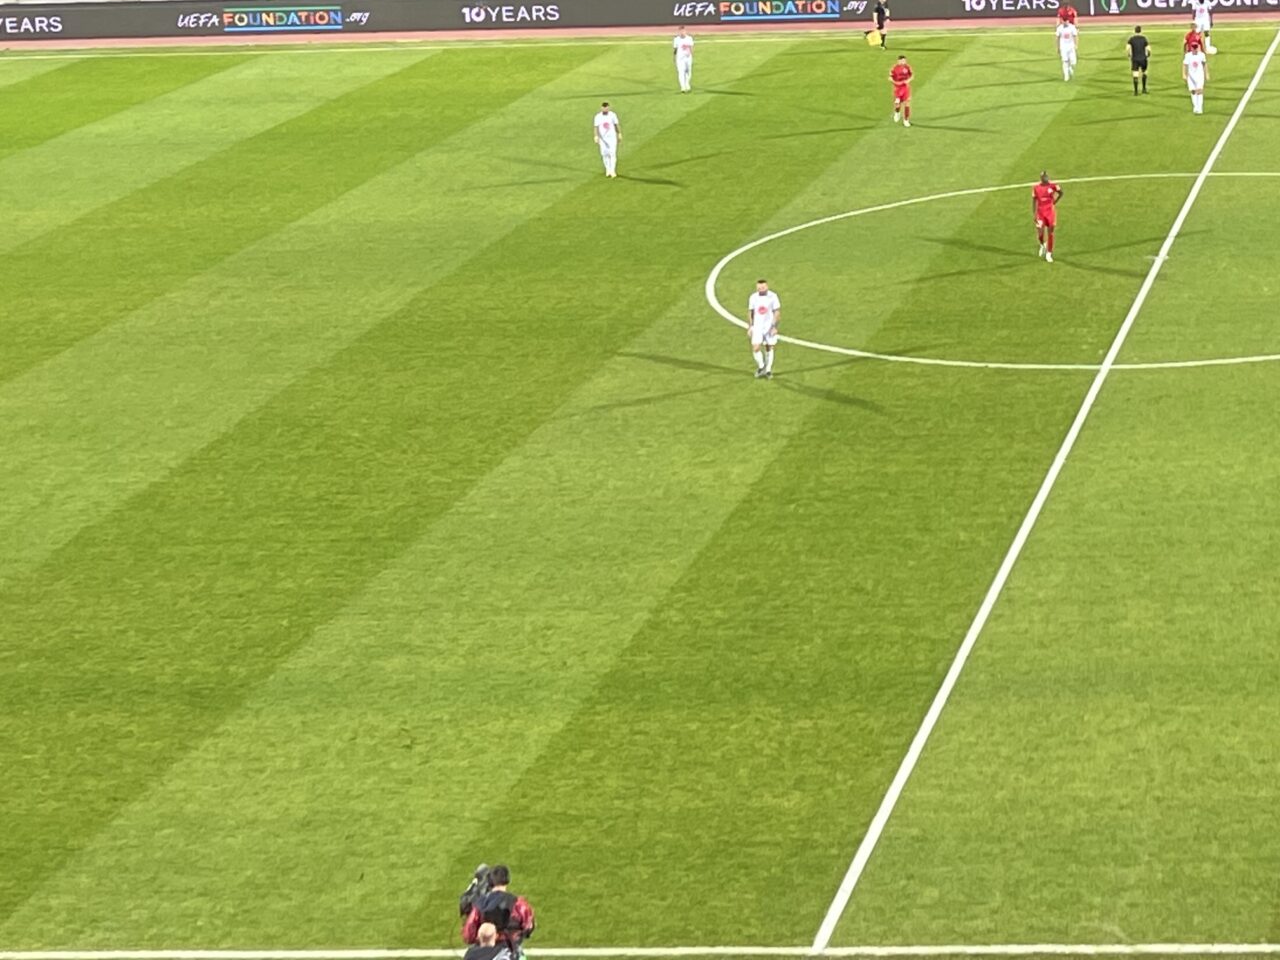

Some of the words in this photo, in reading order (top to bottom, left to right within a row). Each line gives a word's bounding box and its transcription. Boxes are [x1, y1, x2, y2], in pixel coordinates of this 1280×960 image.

[674, 2, 716, 16] UEFA
[719, 0, 839, 14] FOUNDATION
[177, 14, 219, 28] UEFA
[223, 11, 343, 27] FOUNDATION
